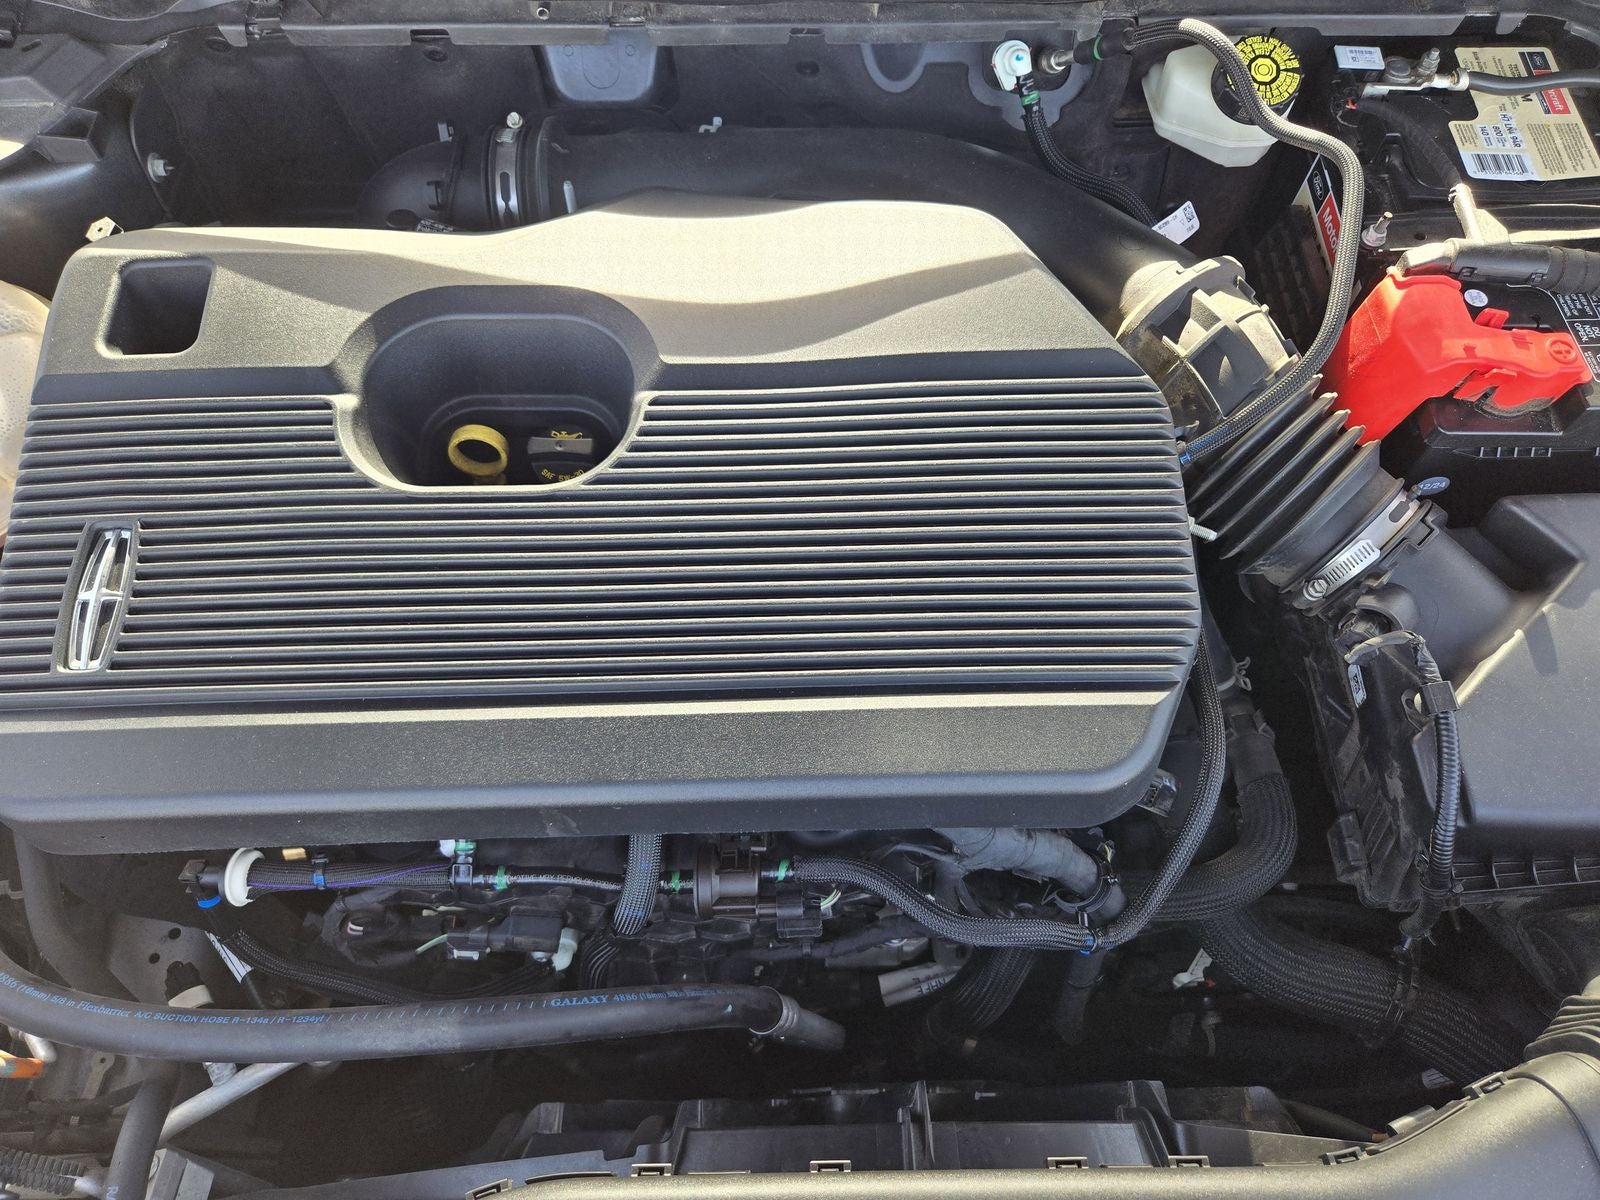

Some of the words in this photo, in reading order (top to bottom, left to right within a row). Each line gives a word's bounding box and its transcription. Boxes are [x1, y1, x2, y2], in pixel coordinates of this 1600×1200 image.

[1313, 172, 1323, 199] Ford
[1574, 322, 1588, 342] OPEN.
[1583, 324, 1596, 339] NOT
[541, 469, 556, 480] SAE
[551, 994, 609, 1008] GALAXY
[613, 992, 638, 1002] 4886
[51, 995, 67, 1007] 5/8
[134, 1011, 152, 1019] A/C
[154, 1012, 199, 1023] SUCTION
[200, 1015, 230, 1025] HOSE
[231, 1015, 269, 1025] R-134a
[277, 1014, 325, 1025] R-1234yf
